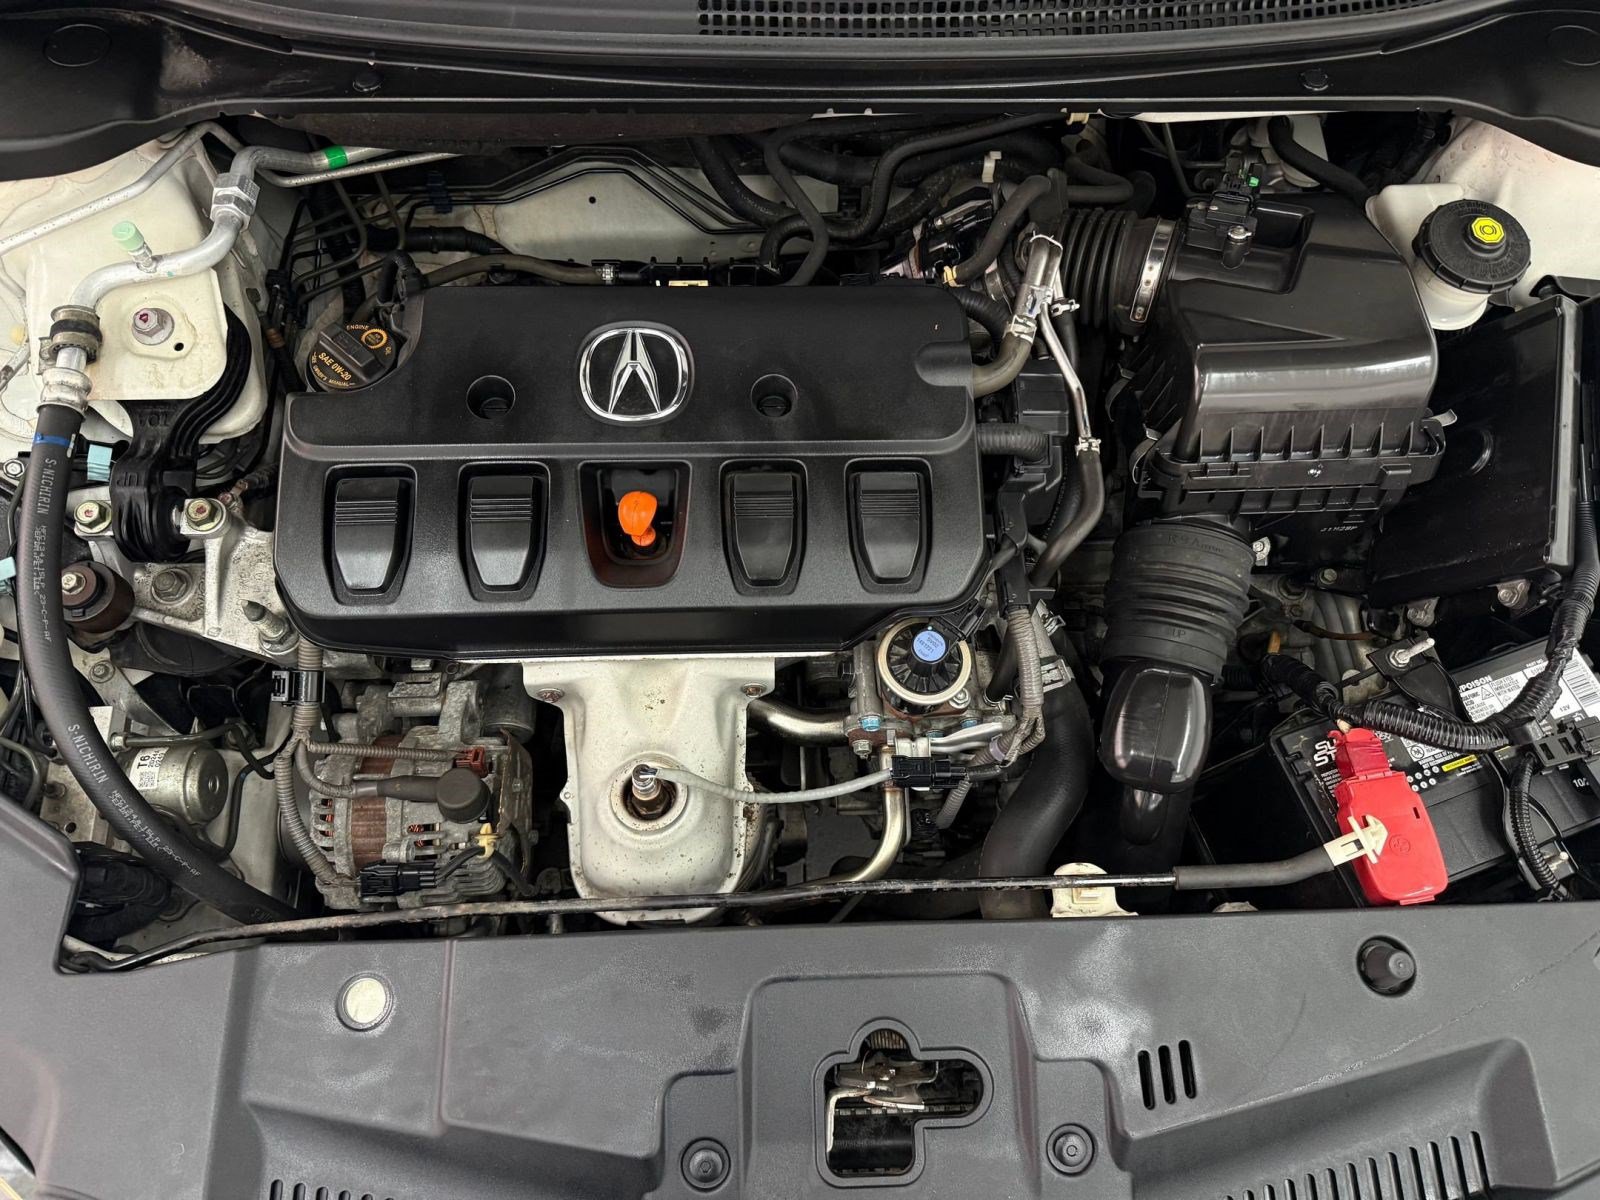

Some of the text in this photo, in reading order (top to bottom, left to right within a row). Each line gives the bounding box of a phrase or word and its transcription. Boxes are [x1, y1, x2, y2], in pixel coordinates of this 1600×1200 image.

[318, 352, 352, 381] SAE 0W-20
[1559, 704, 1571, 712] 12V
[136, 754, 151, 770] T6
